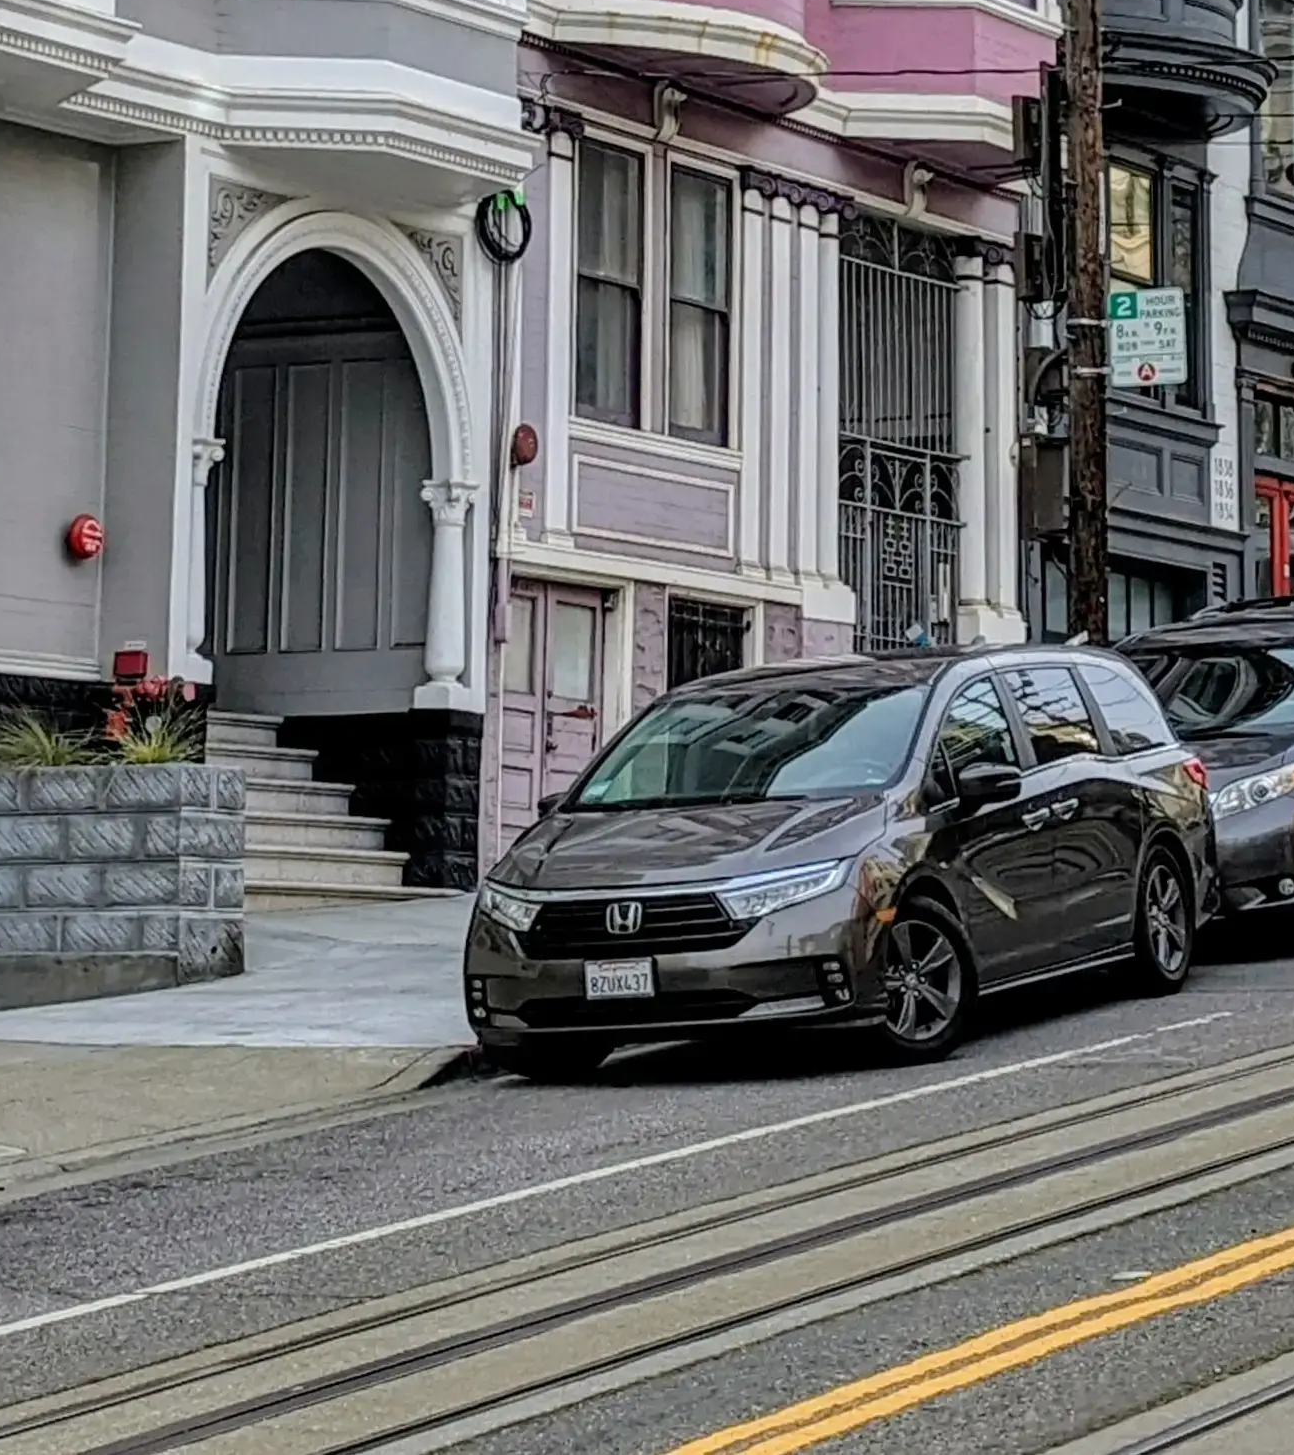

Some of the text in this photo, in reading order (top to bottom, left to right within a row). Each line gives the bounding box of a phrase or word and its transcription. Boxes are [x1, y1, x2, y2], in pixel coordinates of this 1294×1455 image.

[1116, 295, 1176, 317] 2 HOUR
[1140, 307, 1182, 319] PARKING
[1159, 339, 1176, 349] SAT
[590, 973, 649, 994] 8ZUX437
